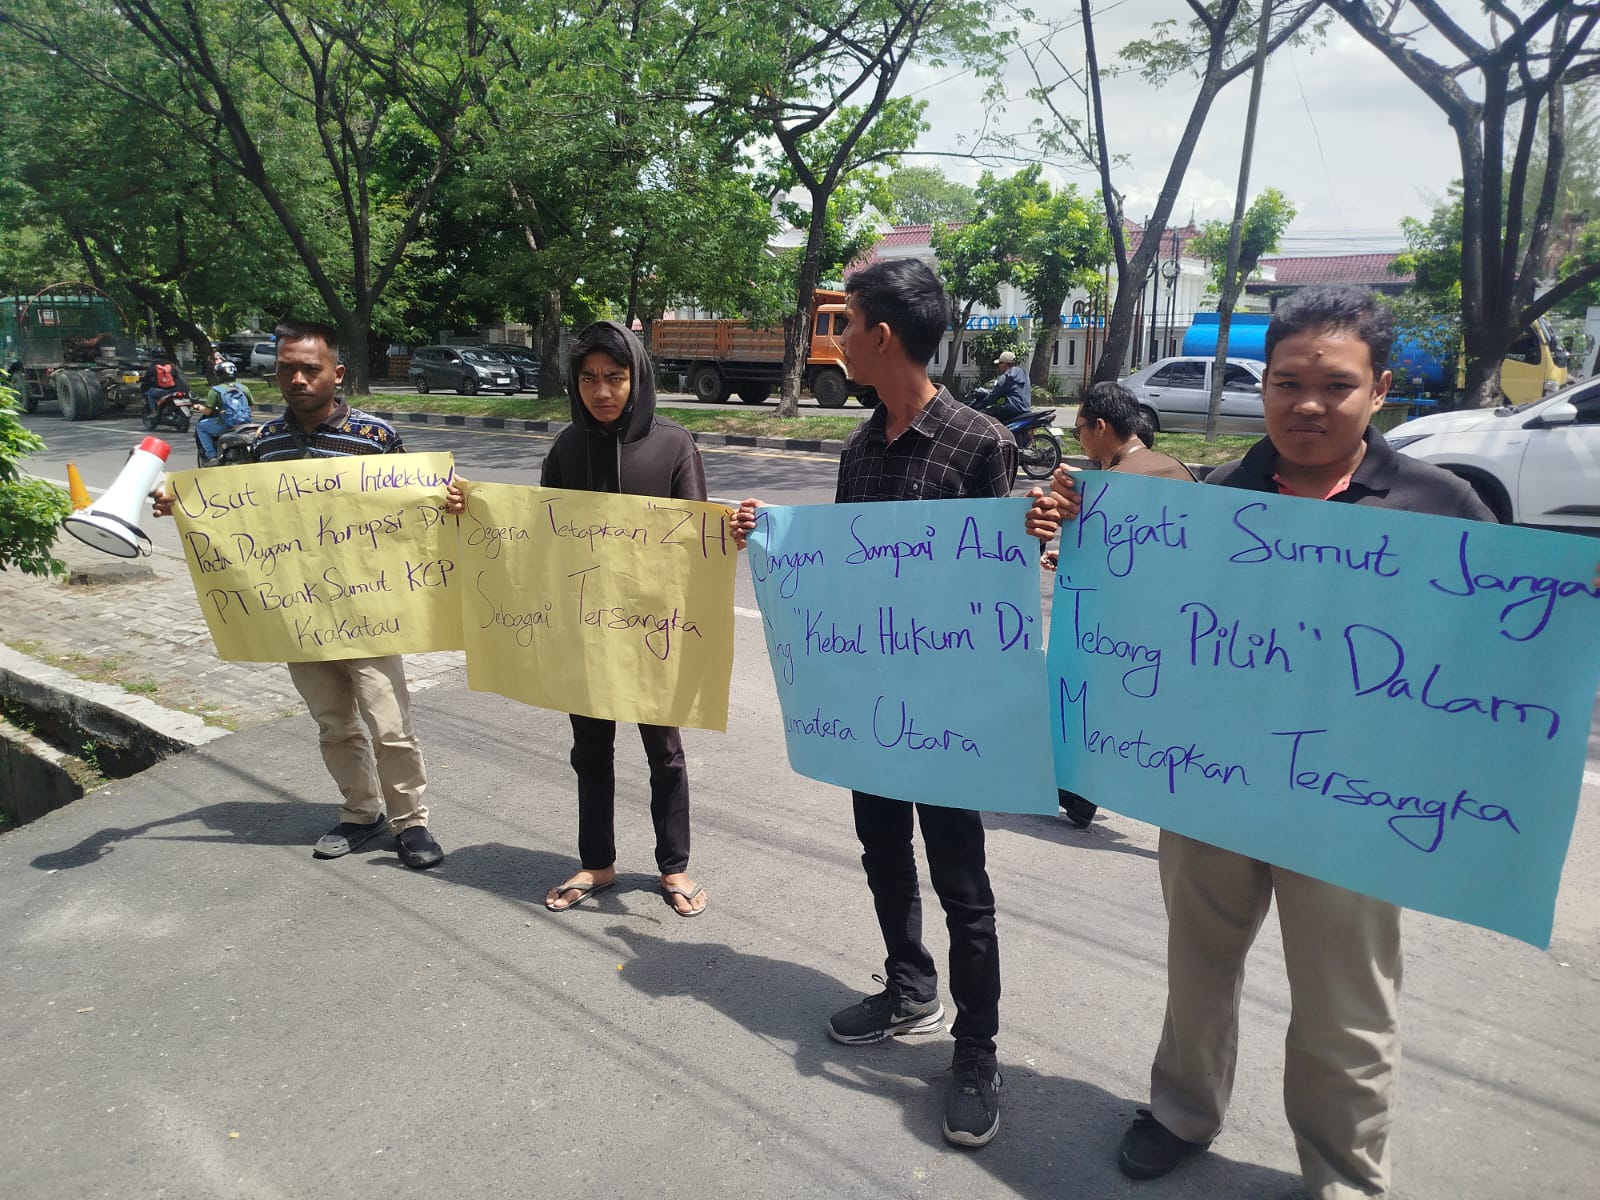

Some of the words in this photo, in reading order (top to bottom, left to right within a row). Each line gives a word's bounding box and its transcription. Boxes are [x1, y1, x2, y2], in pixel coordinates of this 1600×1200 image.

[172, 477, 262, 520] Usut
[277, 470, 348, 503] Aktor
[466, 489, 530, 560] Segera
[540, 497, 649, 553] Tetapkan
[186, 531, 234, 575] Pada
[230, 532, 303, 577] Dugaan
[316, 509, 405, 550] Korupsi
[416, 505, 446, 531] Di
[752, 511, 824, 599] Jangan
[845, 514, 936, 579] Sampai
[956, 516, 1028, 568] Ada
[1076, 481, 1190, 578] Kejati
[1228, 502, 1401, 577] Sumut
[1429, 531, 1600, 643] Janga
[206, 588, 250, 625] PT
[254, 582, 321, 612] Bank
[322, 566, 393, 602] Sumut
[405, 559, 455, 593] KCP
[476, 570, 553, 648] Sebagai
[567, 564, 703, 661] Tersangka
[294, 615, 401, 649] Krakatau
[793, 607, 868, 657] "Kebal
[994, 601, 1034, 652] Di
[1342, 623, 1561, 740] Dalam
[872, 695, 982, 758] Utara
[1059, 676, 1251, 795] Menetapkan
[1270, 729, 1521, 854] Tersangka
